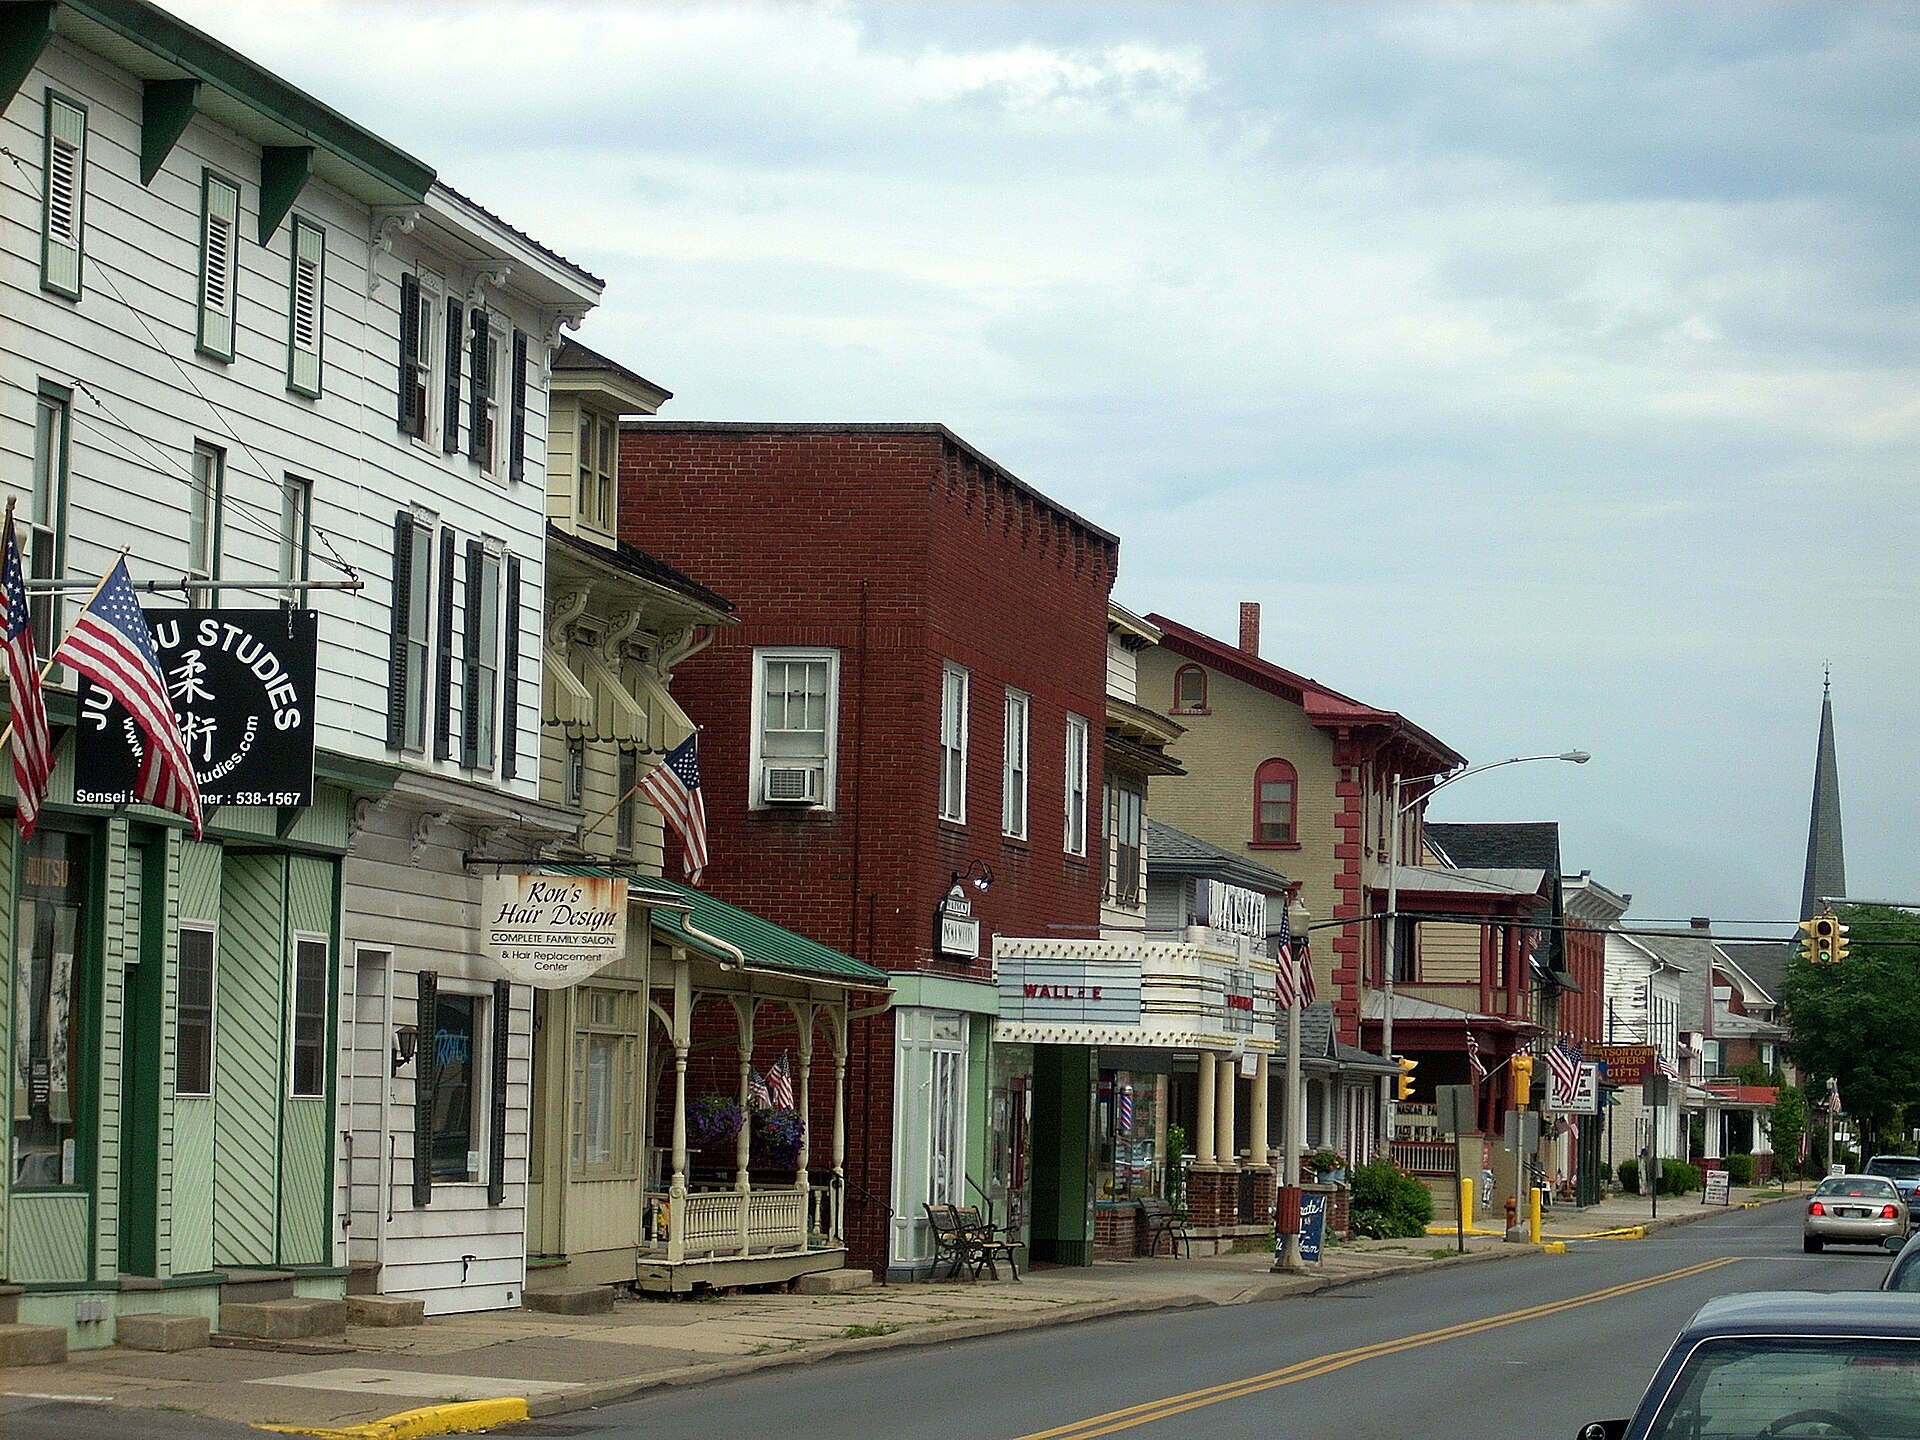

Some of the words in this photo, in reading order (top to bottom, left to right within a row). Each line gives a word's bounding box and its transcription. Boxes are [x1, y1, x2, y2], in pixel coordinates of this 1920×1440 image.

[197, 619, 301, 731] STUDIES
[76, 789, 126, 803] Sensei
[236, 791, 301, 805] 538-1567
[527, 881, 582, 903] Ron's
[492, 902, 543, 924] Hair
[550, 904, 617, 931] Design
[491, 933, 542, 943] COMPLETE
[546, 935, 579, 944] FAMILY
[581, 936, 614, 945] SALON
[502, 951, 509, 959] &
[512, 951, 530, 959] Hair
[534, 952, 602, 961] Replacement
[534, 962, 568, 971] Center
[1607, 1068, 1640, 1077] GIFTS
